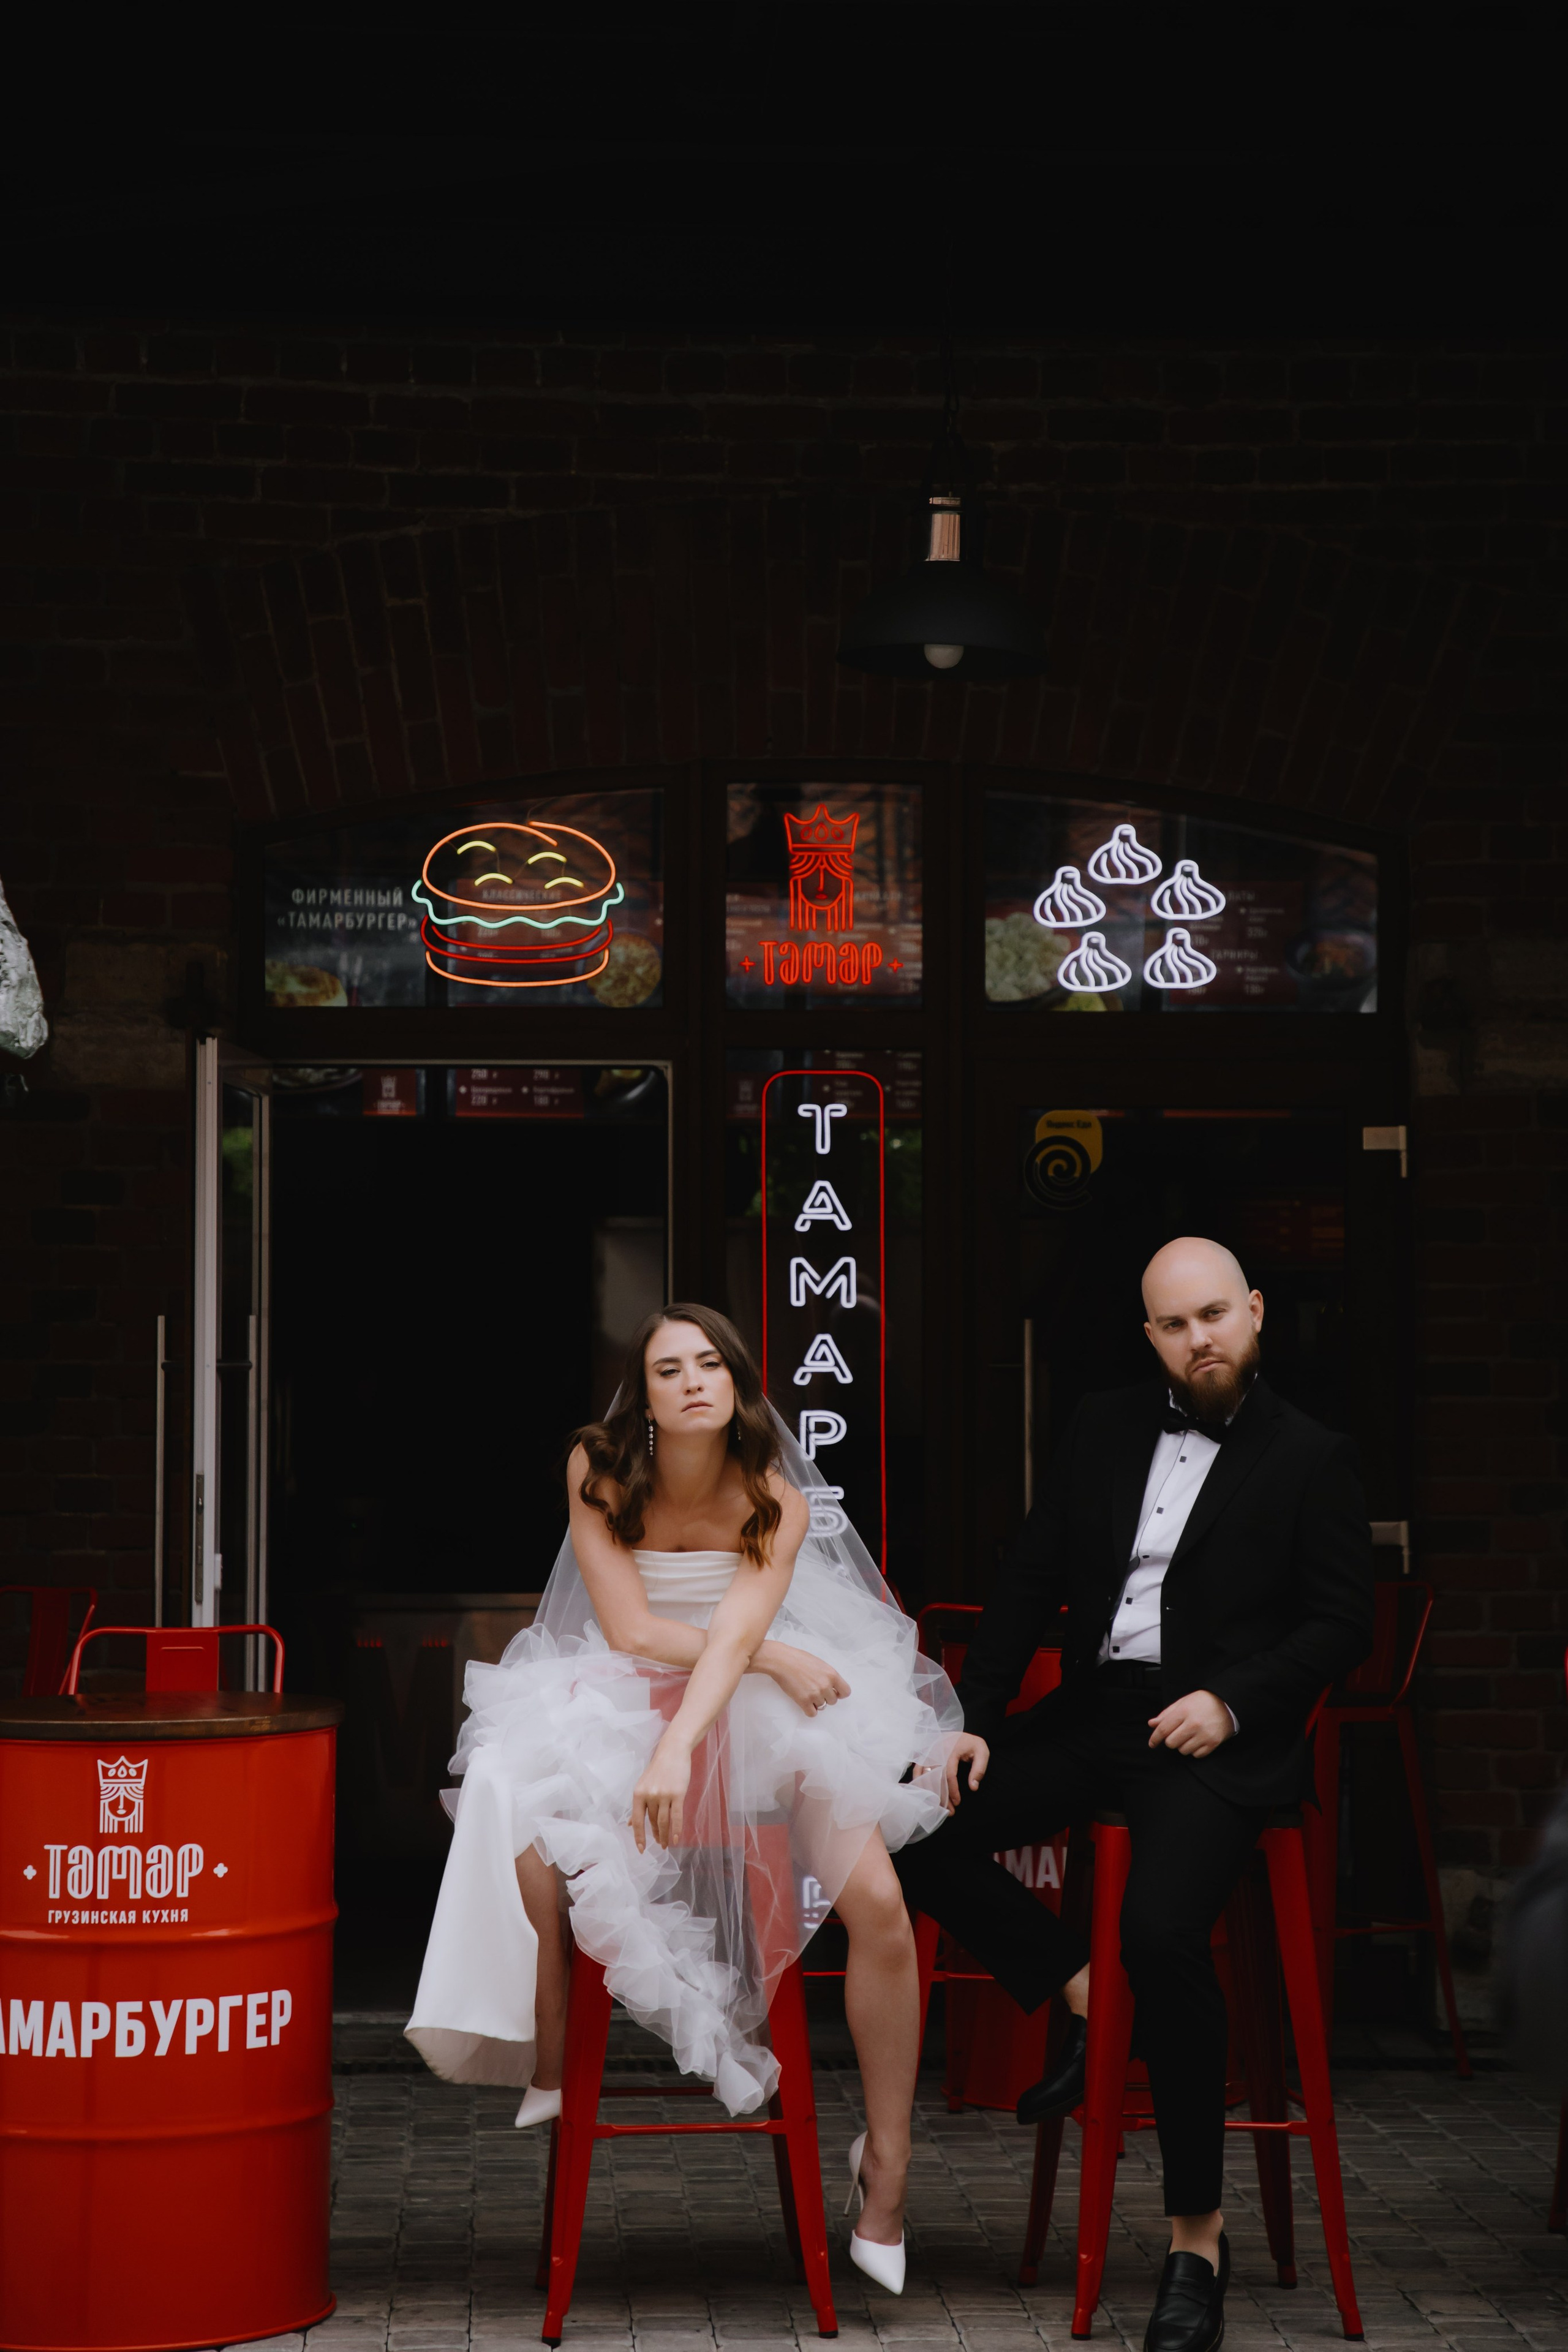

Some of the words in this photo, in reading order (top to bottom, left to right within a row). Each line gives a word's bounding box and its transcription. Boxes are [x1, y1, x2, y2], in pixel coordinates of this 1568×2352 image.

[292, 887, 404, 907] ФИРМЕННЫЙ
[993, 1845, 1068, 1889] МА
[47, 1909, 137, 1925] ГРУЗИНСКАЯ
[141, 1908, 189, 1924] КУХНЯ
[0, 1988, 293, 2059] МАРБУРГЕР
